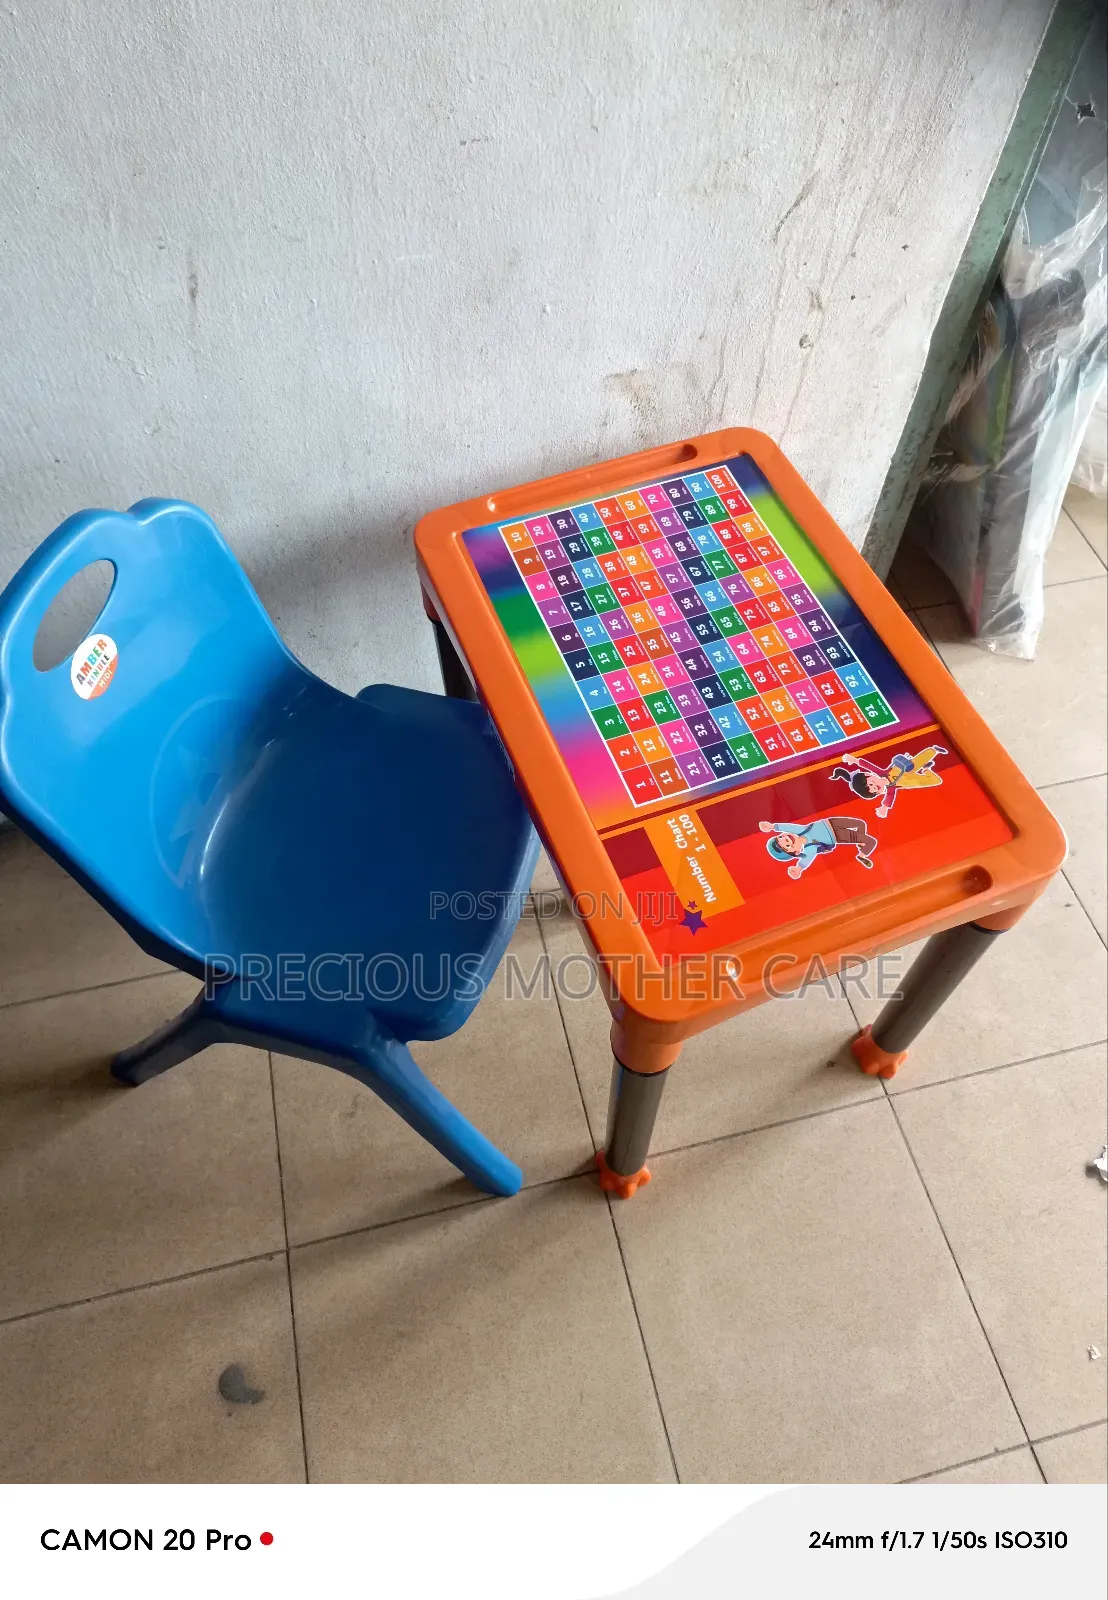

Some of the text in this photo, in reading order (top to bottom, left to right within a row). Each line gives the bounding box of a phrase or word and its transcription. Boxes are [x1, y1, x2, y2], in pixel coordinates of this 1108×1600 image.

[690, 481, 703, 493] 90
[710, 473, 726, 489] 100
[646, 493, 659, 505] 70
[668, 487, 681, 499] 80
[624, 499, 637, 511] 60
[704, 504, 717, 515] 89
[726, 498, 739, 510] 99
[578, 512, 589, 523] 40
[599, 506, 612, 519] 50
[682, 510, 695, 522] 79
[556, 518, 569, 530] 30
[637, 522, 650, 534] 59
[660, 516, 672, 527] 69
[741, 521, 754, 533] 98
[510, 531, 523, 543] 10
[532, 525, 545, 537] 20
[612, 529, 624, 541] 49
[719, 528, 732, 540] 88
[590, 535, 603, 547] 39
[674, 540, 687, 552] 68
[696, 534, 710, 547] 78
[544, 548, 557, 560] 19
[568, 541, 581, 554] 29
[651, 547, 664, 559] 58
[756, 545, 771, 557] 97
[523, 557, 533, 565] 9
[625, 554, 638, 566] 48
[711, 559, 725, 571] 77
[734, 553, 748, 564] 87
[581, 567, 594, 579] 28
[603, 560, 617, 573] 38
[688, 566, 702, 577] 67
[557, 574, 570, 587] 18
[665, 573, 679, 584] 57
[773, 568, 787, 581] 96
[535, 583, 546, 591] 8
[639, 580, 652, 591] 47
[750, 575, 764, 588] 86
[617, 587, 631, 598] 37
[704, 590, 717, 602] 66
[727, 583, 741, 596] 76
[594, 593, 608, 605] 27
[680, 597, 694, 610] 56
[790, 593, 804, 606] 95
[569, 601, 583, 612] 17
[654, 605, 666, 617] 46
[766, 600, 781, 613] 85
[631, 611, 645, 624] 36
[743, 608, 757, 621] 75
[608, 618, 622, 631] 26
[719, 616, 733, 628] 65
[807, 619, 822, 632] 94
[583, 625, 596, 638] 16
[695, 623, 709, 636] 55
[784, 627, 798, 640] 84
[669, 631, 682, 643] 45
[759, 635, 773, 648] 74
[622, 644, 637, 658] 25
[646, 638, 660, 651] 35
[735, 642, 750, 655] 64
[597, 652, 611, 665] 15
[711, 650, 726, 663] 54
[825, 646, 840, 659] 93
[76, 639, 107, 685] AMBER
[574, 661, 586, 669] 5
[684, 658, 697, 671] 44
[802, 654, 816, 667] 83
[87, 654, 110, 687] KINDLE
[661, 665, 675, 679] 34
[777, 662, 792, 676] 73
[98, 669, 113, 688] MIDI
[637, 672, 652, 686] 24
[753, 670, 767, 683] 63
[844, 674, 859, 688] 92
[611, 679, 625, 693] 14
[728, 678, 743, 692] 53
[820, 682, 835, 696] 82
[589, 689, 599, 697] 4
[701, 686, 714, 699] 43
[795, 690, 810, 705] 72
[677, 693, 691, 707] 33
[770, 698, 785, 713] 62
[653, 701, 667, 715] 23
[745, 706, 760, 721] 52
[864, 703, 879, 718] 91
[626, 708, 641, 722] 13
[839, 711, 854, 726] 81
[604, 718, 615, 726] 3
[718, 715, 731, 729] 42
[814, 720, 829, 735] 71
[693, 723, 708, 737] 32
[789, 728, 804, 742] 61
[669, 730, 684, 745] 22
[764, 736, 779, 751] 51
[642, 738, 657, 752] 12
[619, 748, 631, 757] 2
[735, 745, 749, 759] 41
[711, 753, 726, 768] 31
[686, 761, 701, 776] 21
[659, 769, 673, 785] 11
[635, 780, 647, 789] 1
[678, 814, 697, 835] 100
[695, 843, 706, 852] 1
[666, 818, 717, 903] Number Chart
